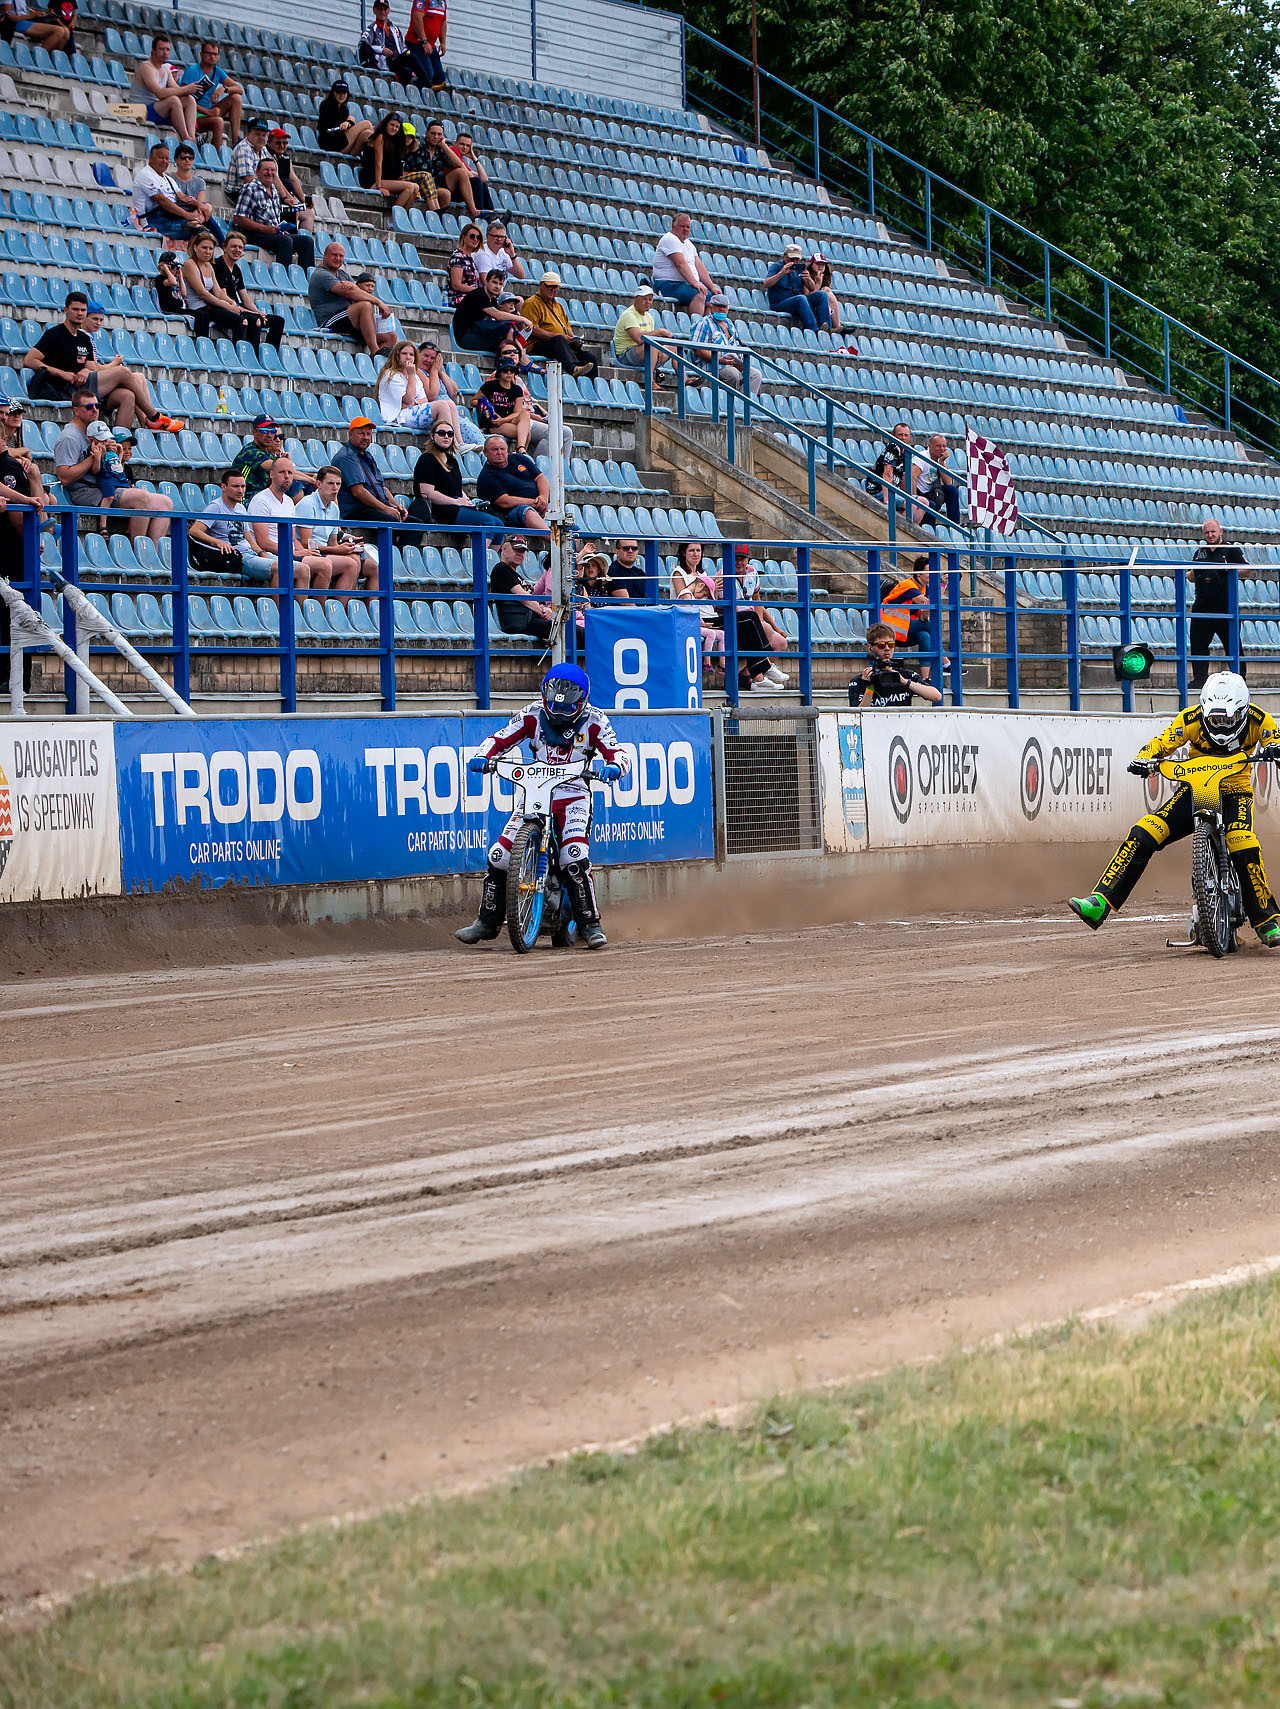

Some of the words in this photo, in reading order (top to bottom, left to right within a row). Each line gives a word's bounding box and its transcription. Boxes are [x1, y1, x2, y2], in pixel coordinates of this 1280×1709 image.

[14, 739, 98, 778] DAUGAVPILS
[918, 744, 978, 796] OPTIBET
[1187, 763, 1233, 775] spechouse
[526, 767, 567, 778] OPTIBET
[1049, 746, 1112, 796] OPTIBET
[141, 749, 322, 826] TRODO
[16, 794, 30, 832] IS
[33, 792, 94, 832] SPEEDWAY
[918, 801, 951, 814] SPORTA
[1048, 801, 1086, 813] SPORTA
[408, 832, 427, 852] CAR
[428, 830, 455, 850] PARTS
[594, 823, 611, 842] CAR
[612, 822, 636, 841] PARTS
[637, 820, 665, 840] ONLINE
[189, 841, 210, 864] CAR
[212, 840, 243, 863] PARTS
[245, 838, 281, 861] ONLINE
